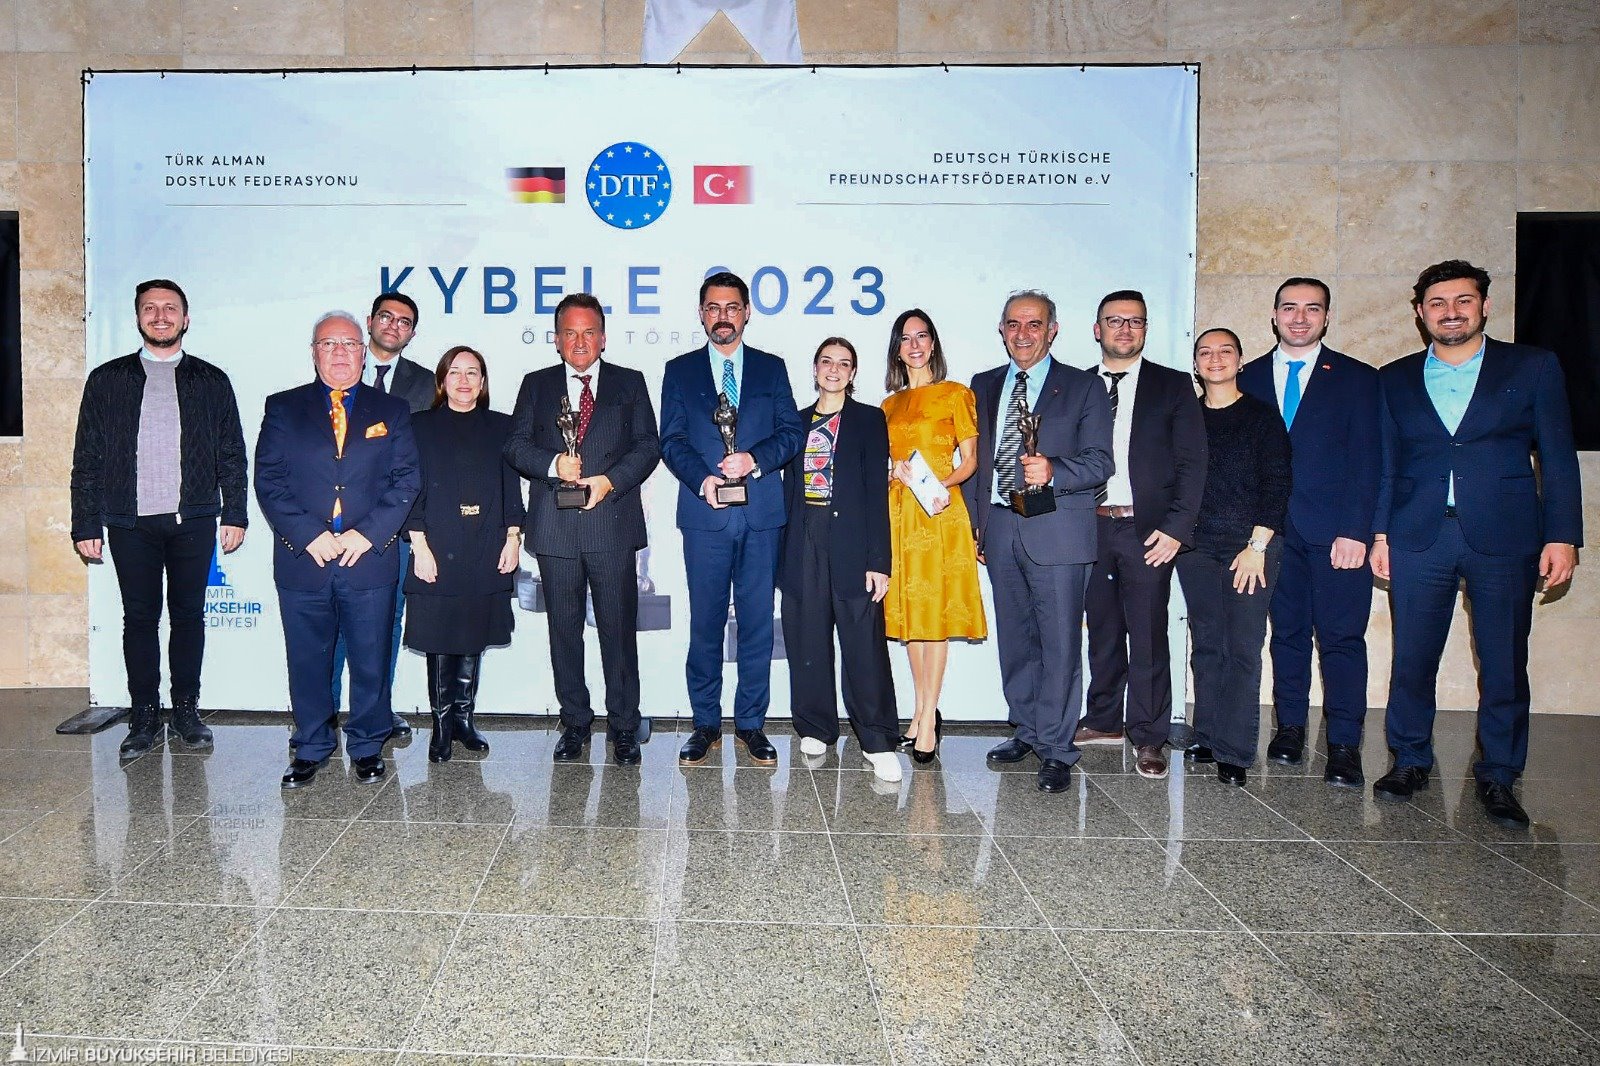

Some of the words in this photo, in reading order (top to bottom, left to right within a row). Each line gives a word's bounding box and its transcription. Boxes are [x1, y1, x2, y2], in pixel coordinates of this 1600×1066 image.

[165, 152, 204, 166] TÜRK
[211, 155, 265, 166] ALMAN
[933, 152, 1010, 164] DEUTSCH
[1018, 150, 1111, 164] TÜRKİSCHE
[165, 175, 237, 187] DOSTLUK
[244, 175, 359, 187] FEDERASYONU
[829, 171, 1077, 185] FREUNDSCHAFTSFÖDERATION
[598, 174, 659, 198] DTF
[704, 265, 886, 316] 023
[625, 328, 702, 345] TÖRE
